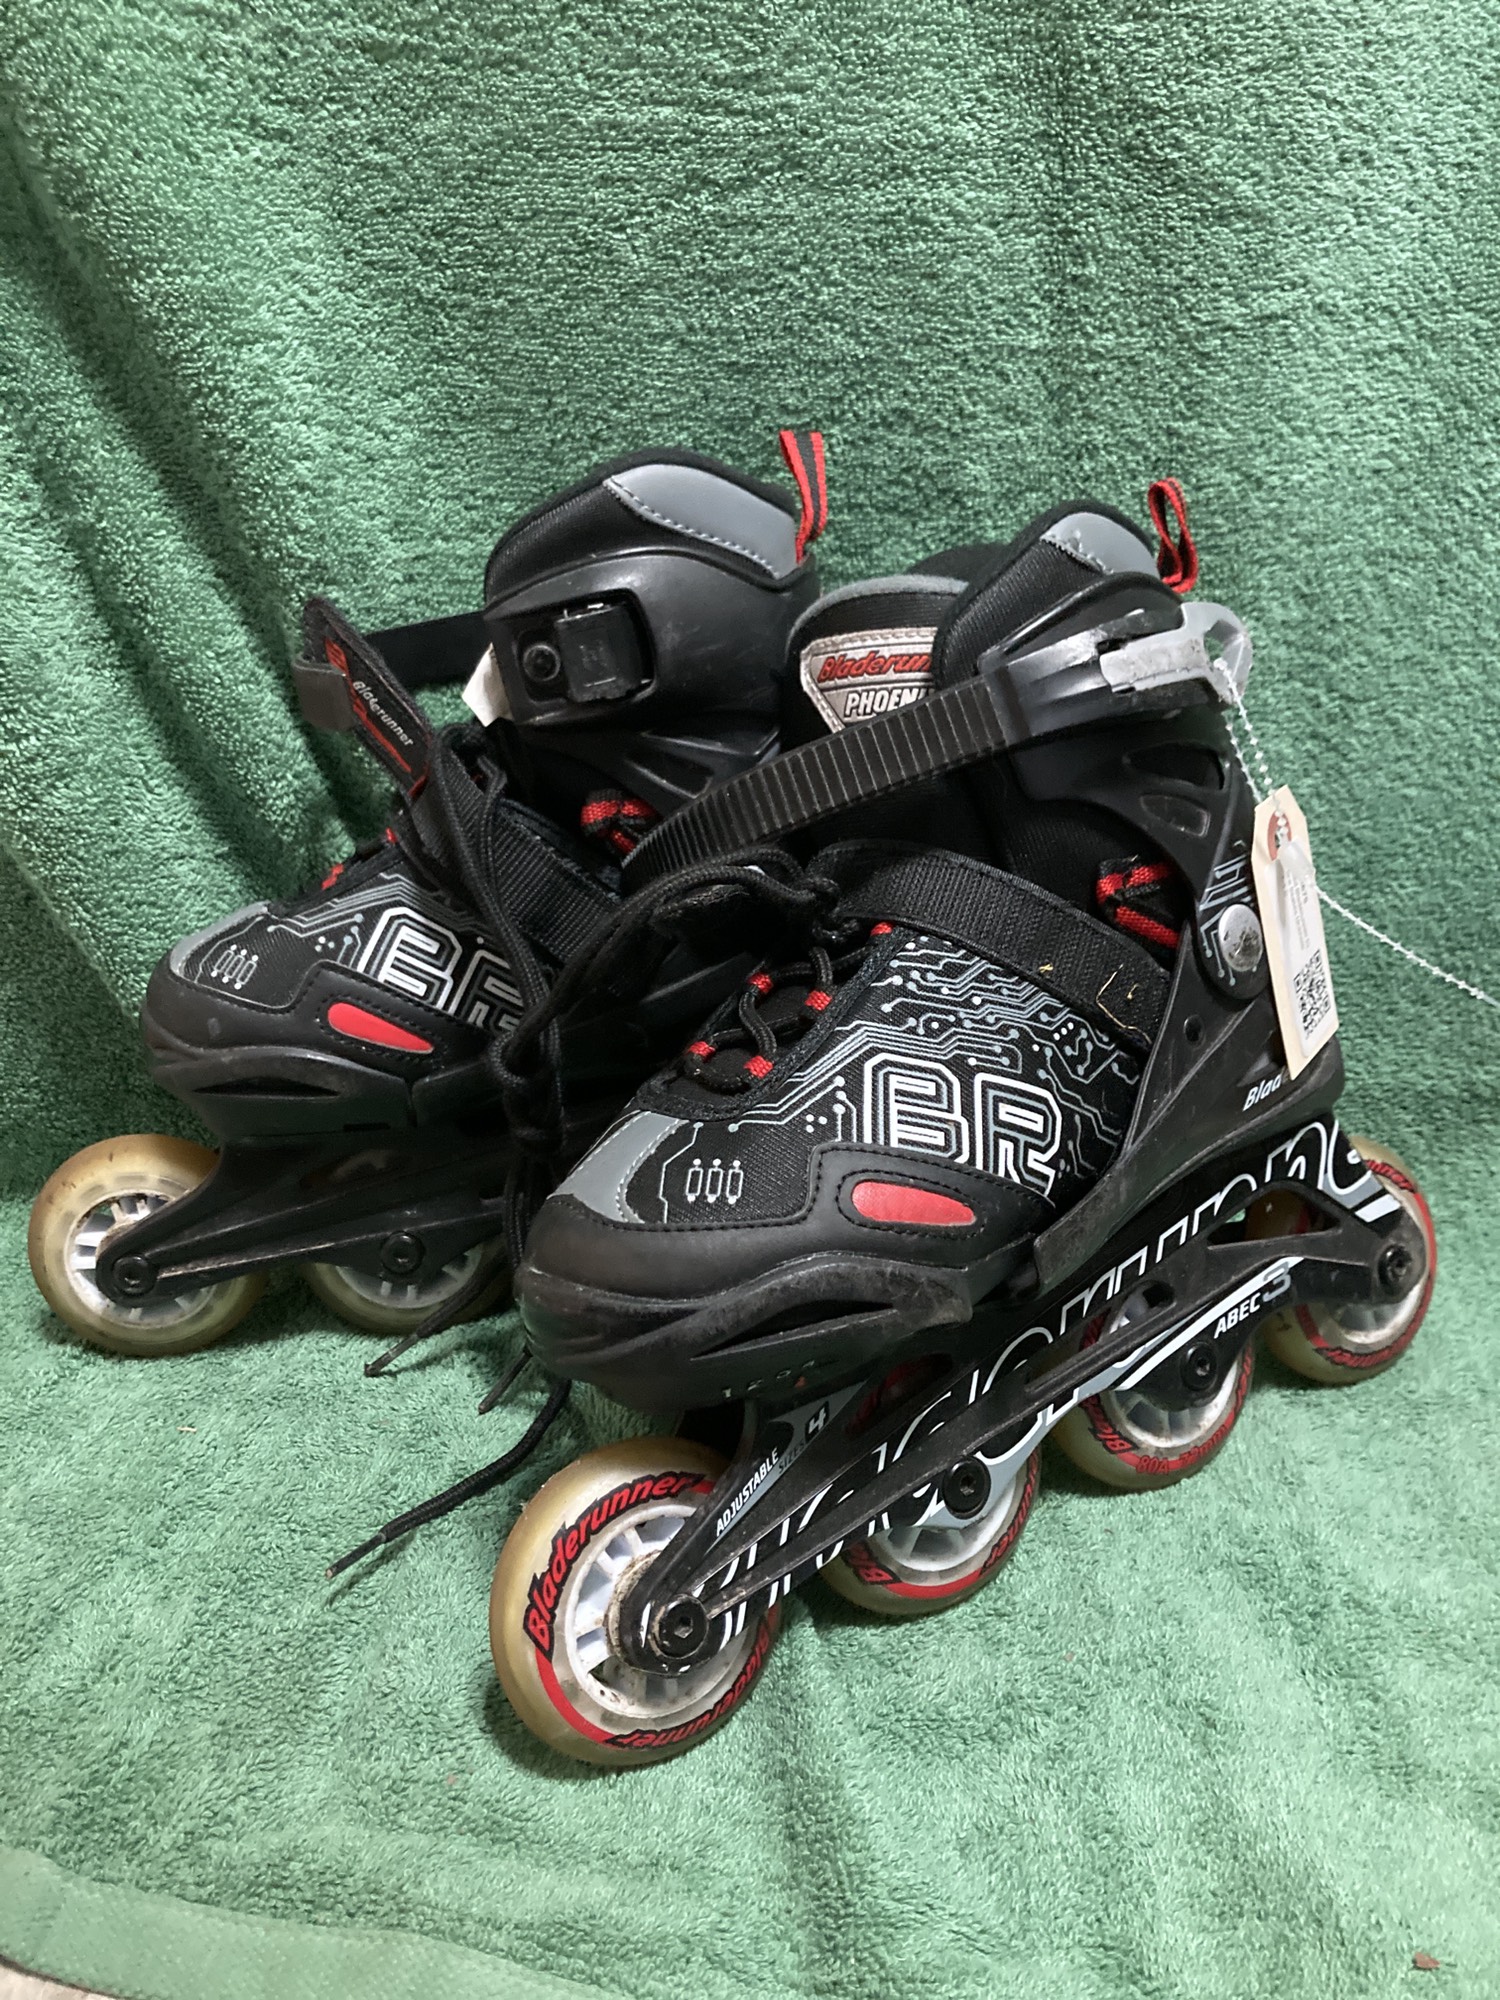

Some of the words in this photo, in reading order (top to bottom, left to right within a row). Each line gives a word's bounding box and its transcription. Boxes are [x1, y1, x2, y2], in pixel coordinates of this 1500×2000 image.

[352, 680, 414, 747] Bladerunner
[1213, 1292, 1261, 1339] ABEC
[1262, 1261, 1292, 1303] 3
[806, 1405, 828, 1436] 4
[716, 1447, 779, 1537] ADJUSTABLE
[523, 1471, 706, 1663] Bladerunner
